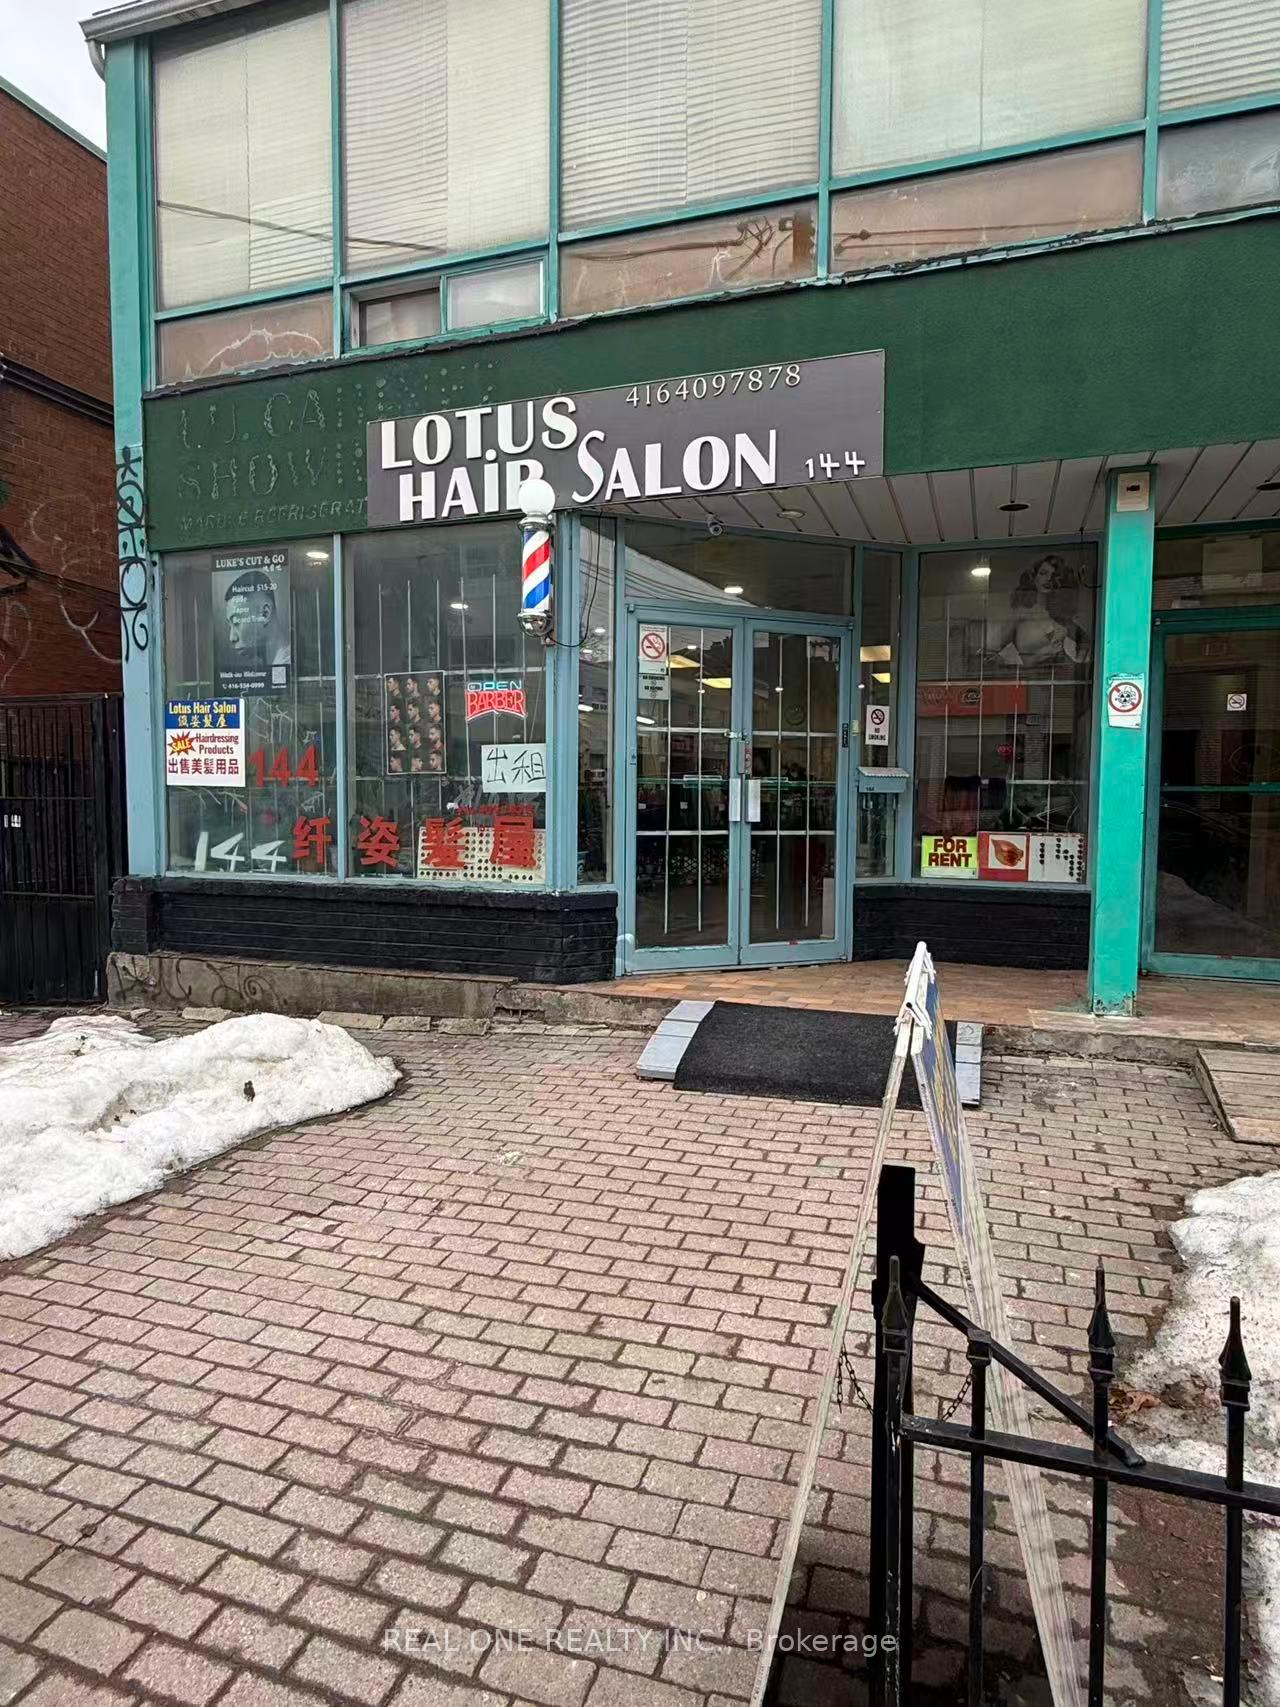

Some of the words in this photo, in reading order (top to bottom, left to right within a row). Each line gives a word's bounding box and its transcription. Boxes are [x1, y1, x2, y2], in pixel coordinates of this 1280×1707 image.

[626, 363, 802, 408] 4164097878
[380, 396, 577, 470] LOTUS
[571, 429, 777, 503] SALON
[805, 450, 866, 480] 144
[216, 557, 244, 569] LUKE'S
[246, 556, 263, 566] CUT
[263, 556, 271, 564] &
[272, 554, 285, 563] GO
[232, 584, 255, 593] Haircut
[467, 680, 522, 691] OPEN
[169, 702, 191, 714] Lotus
[193, 701, 210, 714] Hair
[213, 701, 237, 713] Salon
[467, 690, 526, 717] BARBER
[171, 738, 192, 752] SALE
[196, 733, 239, 745] Hairdressing
[199, 745, 234, 755] Products
[248, 744, 319, 789] 144
[486, 748, 545, 783] 出租
[194, 831, 288, 872] 144
[933, 838, 968, 853] FOR
[928, 852, 972, 867] RENT
